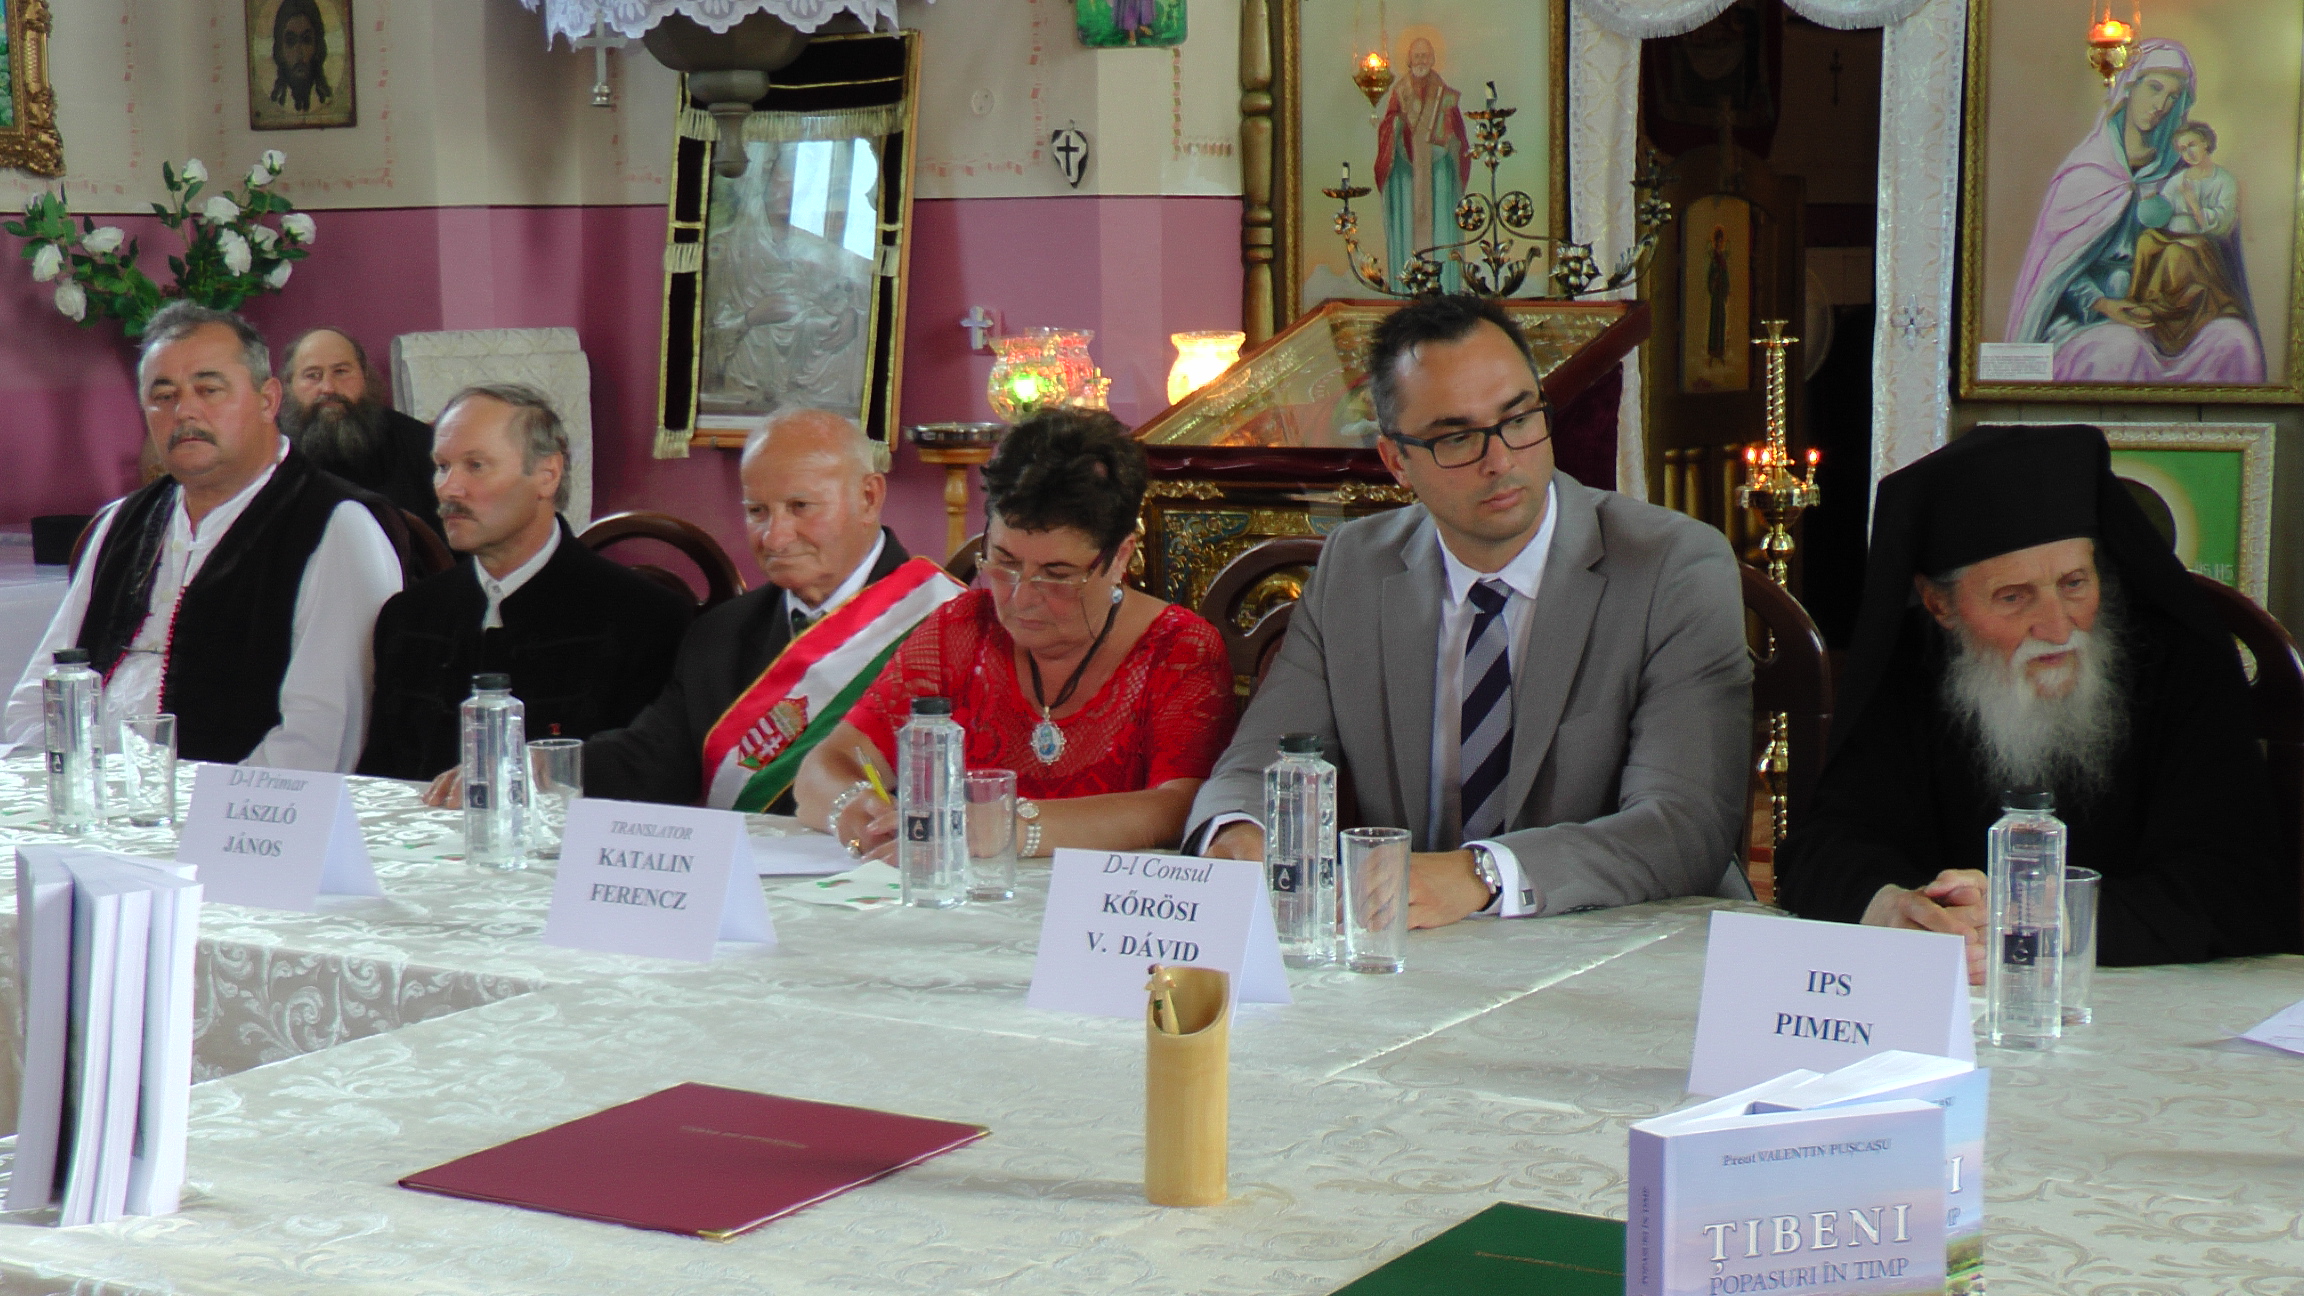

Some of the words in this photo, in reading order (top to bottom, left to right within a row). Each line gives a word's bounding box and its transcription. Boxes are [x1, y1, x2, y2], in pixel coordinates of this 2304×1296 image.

[256, 771, 308, 791] Primar
[225, 799, 297, 825] LÁSZLÓ
[610, 820, 694, 840] TRANSLATOR
[223, 832, 283, 857] JÁNOS
[598, 847, 695, 873] KATALIN
[1142, 858, 1213, 883] Consul
[590, 882, 687, 910] FERENCZ
[1102, 890, 1200, 922] KŐRÖSI
[1087, 931, 1107, 953] V.
[1120, 932, 1199, 962] DÁVID
[1806, 970, 1852, 996] IPS
[1774, 1012, 1874, 1046] PIMEN
[1759, 1145, 1826, 1162] VALENTIN
[1702, 1203, 1911, 1274] ȚIBENI
[1709, 1265, 1818, 1296] POPASURI
[1823, 1261, 1848, 1284] ÎN
[1854, 1257, 1909, 1280] TIMP
